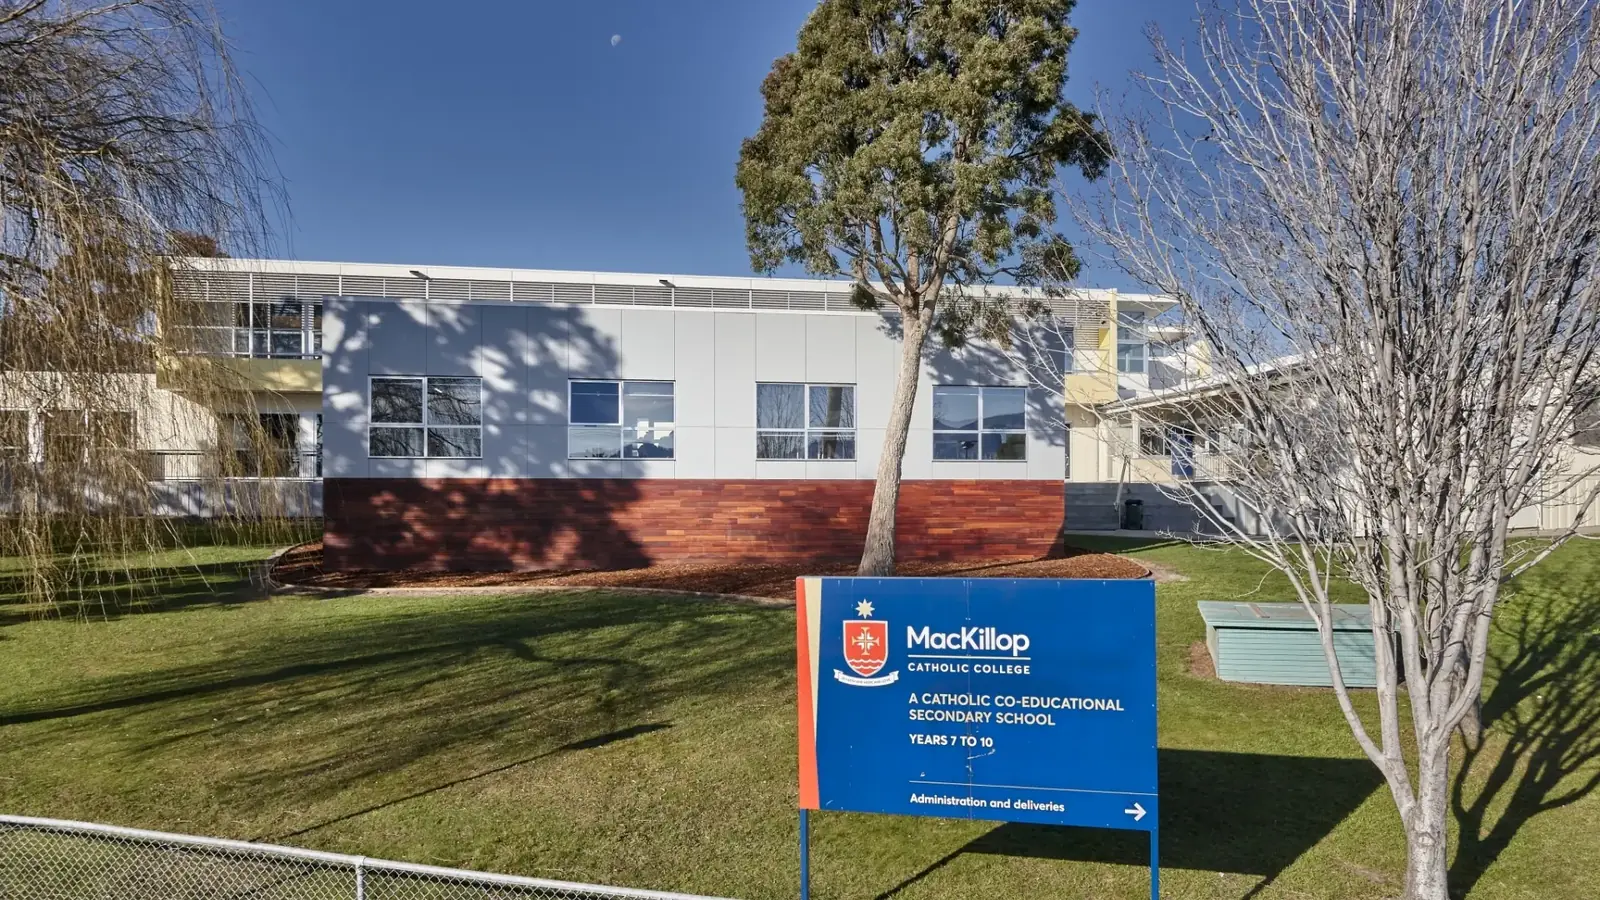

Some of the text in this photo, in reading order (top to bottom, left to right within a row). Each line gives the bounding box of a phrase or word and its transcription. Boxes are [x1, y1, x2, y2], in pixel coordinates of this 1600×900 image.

[906, 625, 1030, 656] MacKillop
[907, 662, 1030, 675] CATHOLIC COLLEGE
[908, 693, 1125, 712] A CATHOLIC CO-EDUCATIONAL
[908, 709, 1056, 726] SECONDARY SCHOOL
[909, 733, 994, 748] YEARS 7 TO 10
[909, 793, 1065, 812] Administration and deliveries
